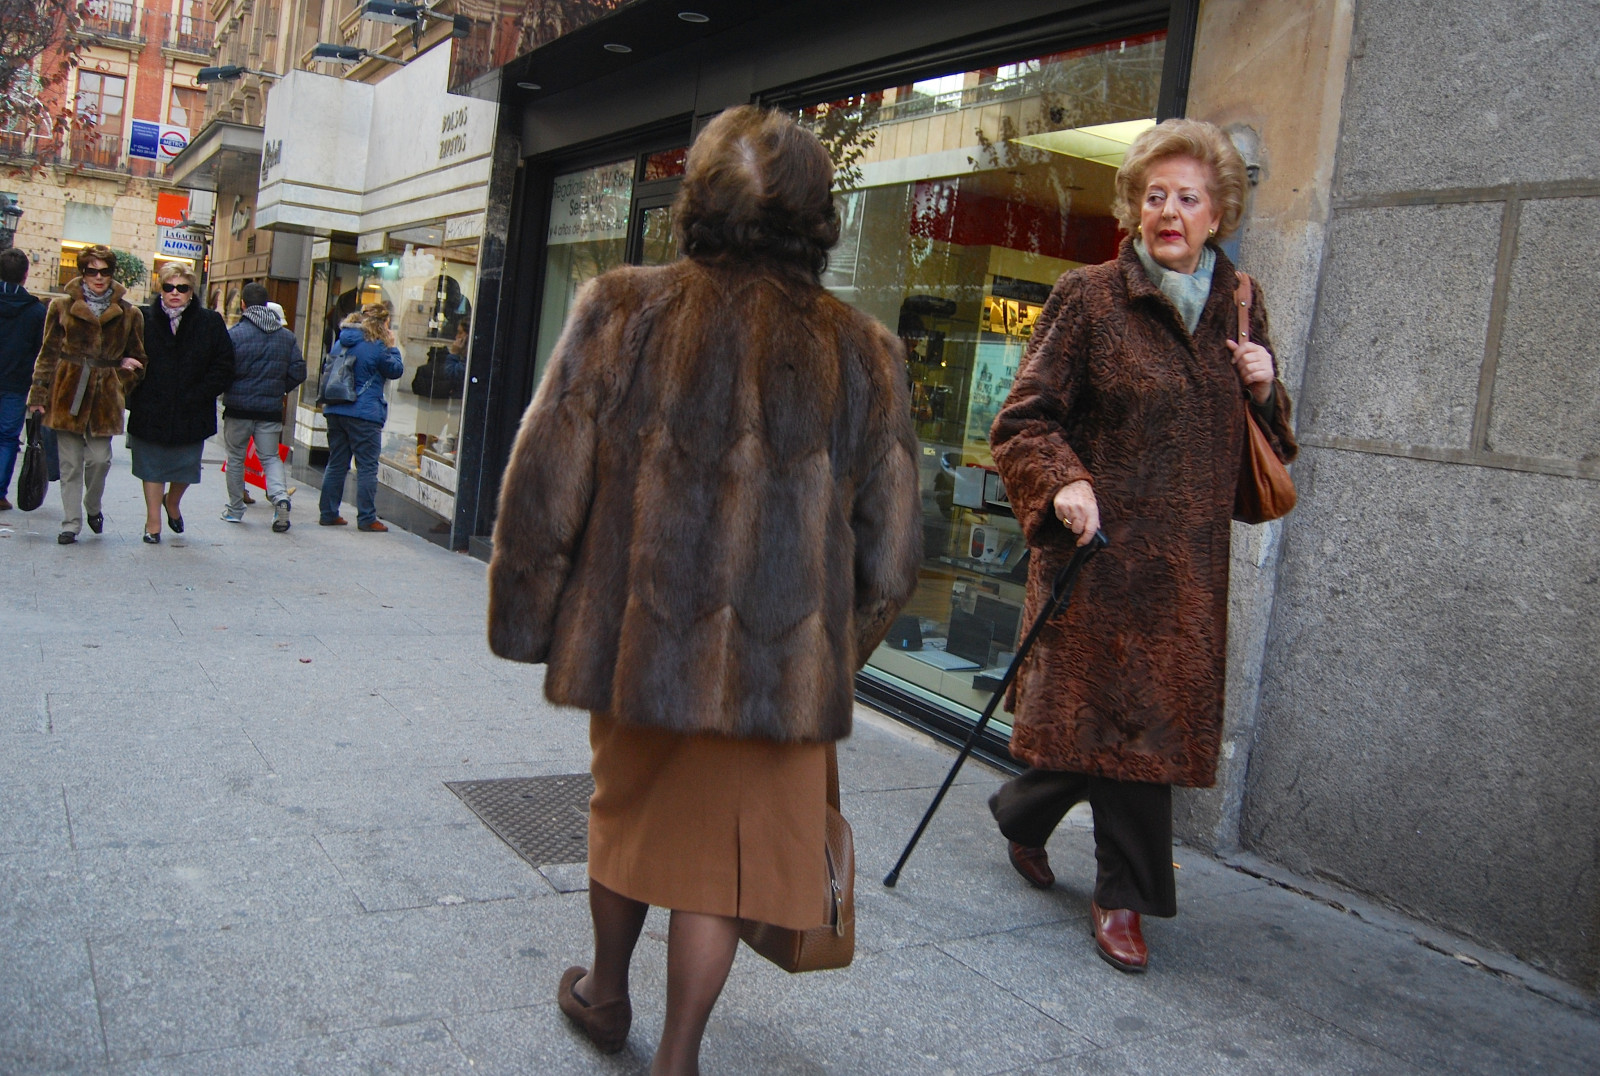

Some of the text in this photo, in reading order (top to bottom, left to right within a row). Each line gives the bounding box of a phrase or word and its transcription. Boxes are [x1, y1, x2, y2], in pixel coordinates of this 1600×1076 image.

[442, 106, 467, 133] BOLSOS
[163, 139, 184, 148] METRO
[157, 216, 184, 226] orang
[164, 240, 203, 252] KIOSKO
